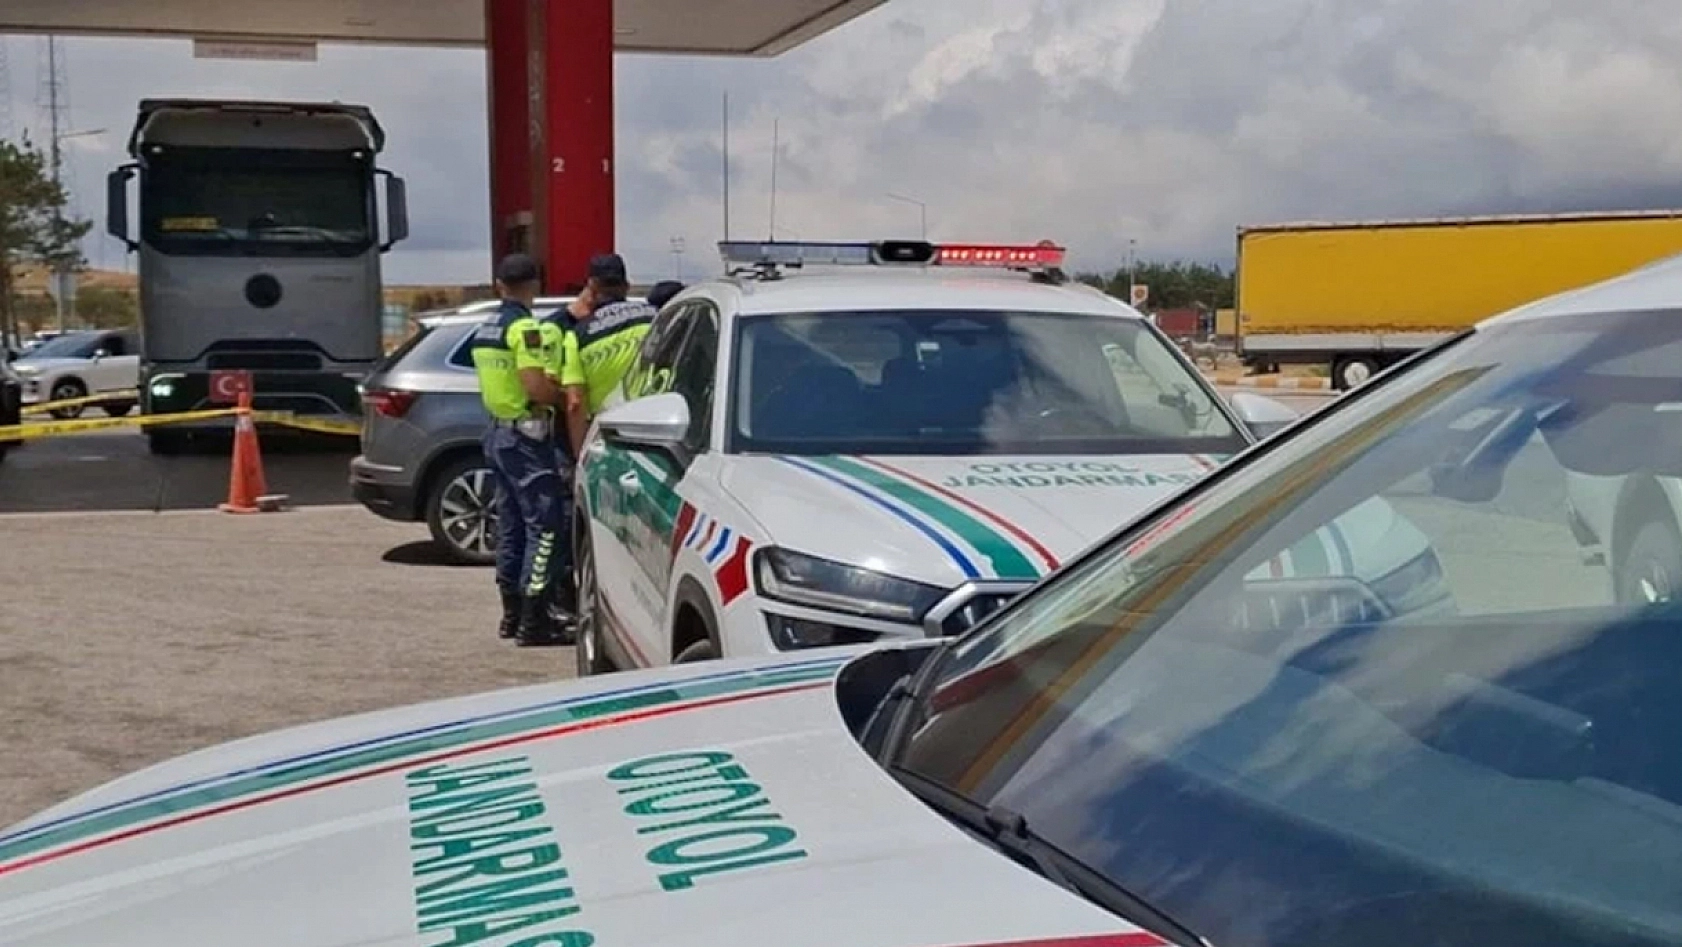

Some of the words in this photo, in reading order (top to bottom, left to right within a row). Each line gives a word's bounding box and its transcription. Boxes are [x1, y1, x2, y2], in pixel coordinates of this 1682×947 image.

[553, 157, 565, 172] 2
[602, 158, 609, 172] 1
[970, 461, 1140, 474] OTOYOL
[606, 750, 808, 892] OTOYOL
